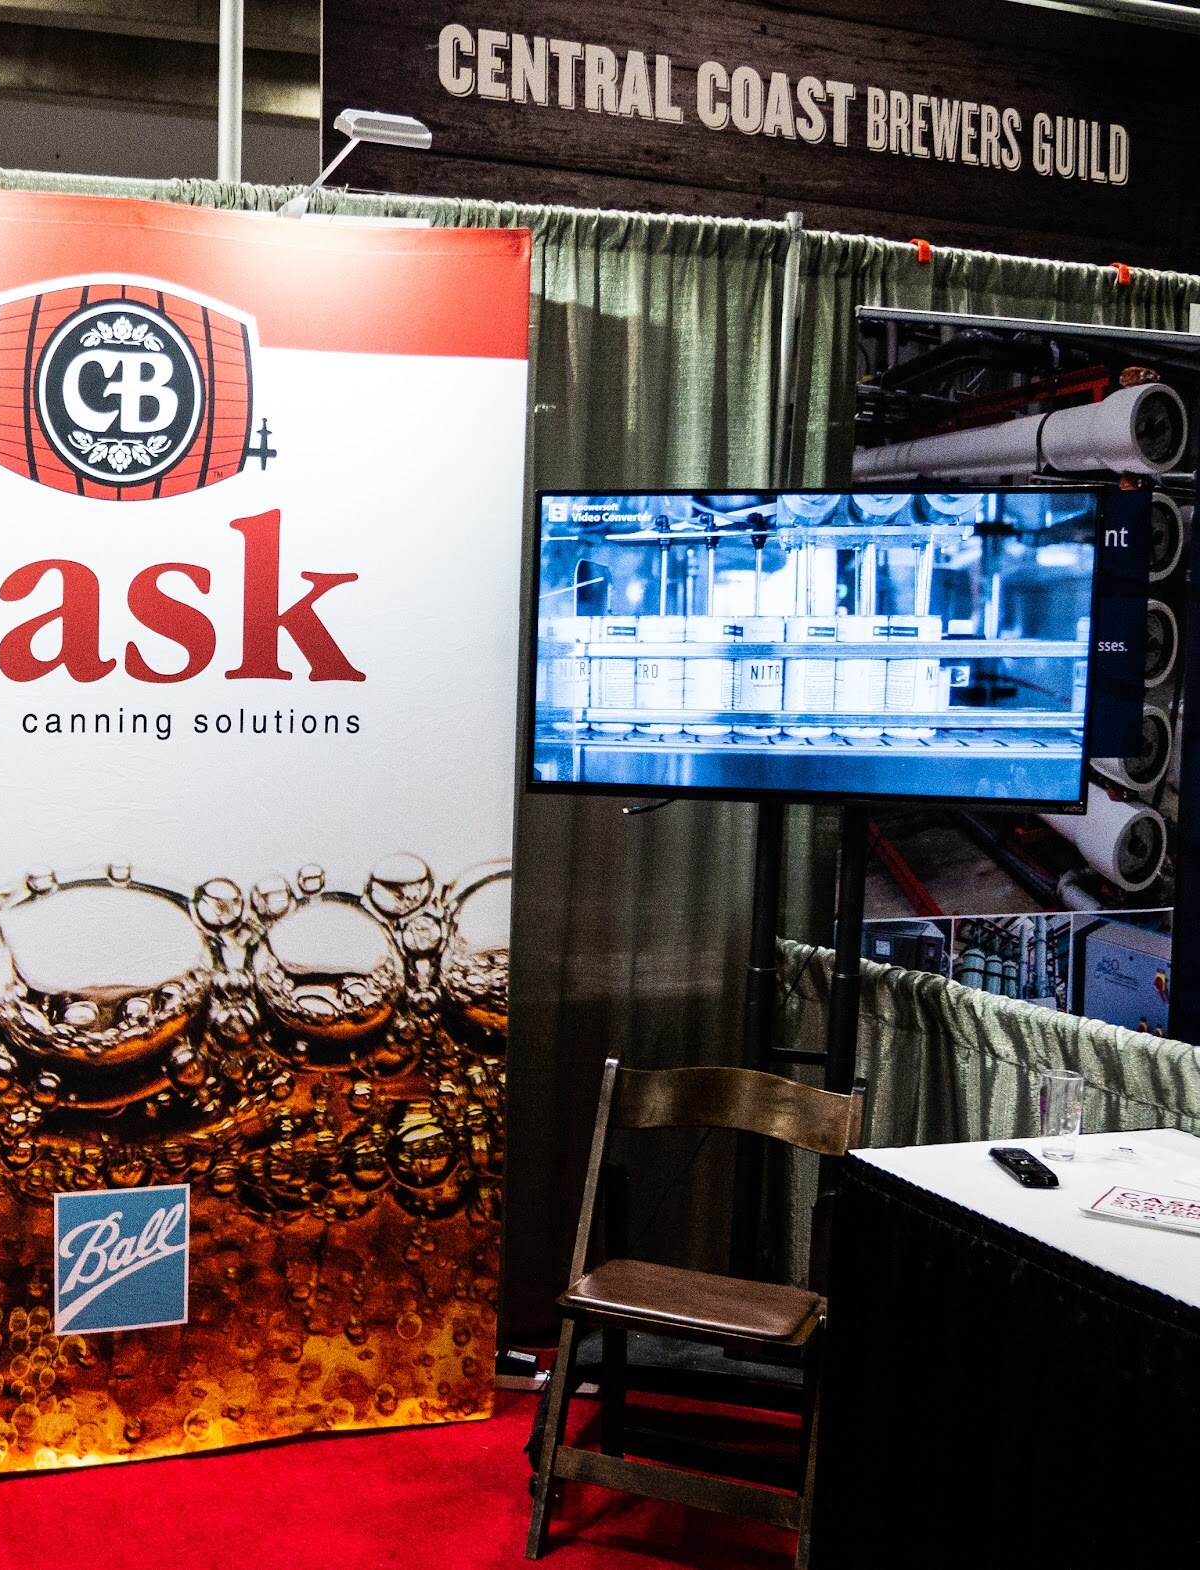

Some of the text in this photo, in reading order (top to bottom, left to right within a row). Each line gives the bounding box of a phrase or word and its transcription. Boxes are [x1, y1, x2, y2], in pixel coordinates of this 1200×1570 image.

[438, 23, 1130, 186] CENTRAL COAST BREWERS GUILD
[62, 349, 179, 433] CB
[571, 503, 619, 512] Apowersoft
[571, 512, 652, 523] Video Converter
[22, 708, 173, 739] canning
[194, 708, 361, 734] solutions
[59, 1203, 185, 1295] Ball
